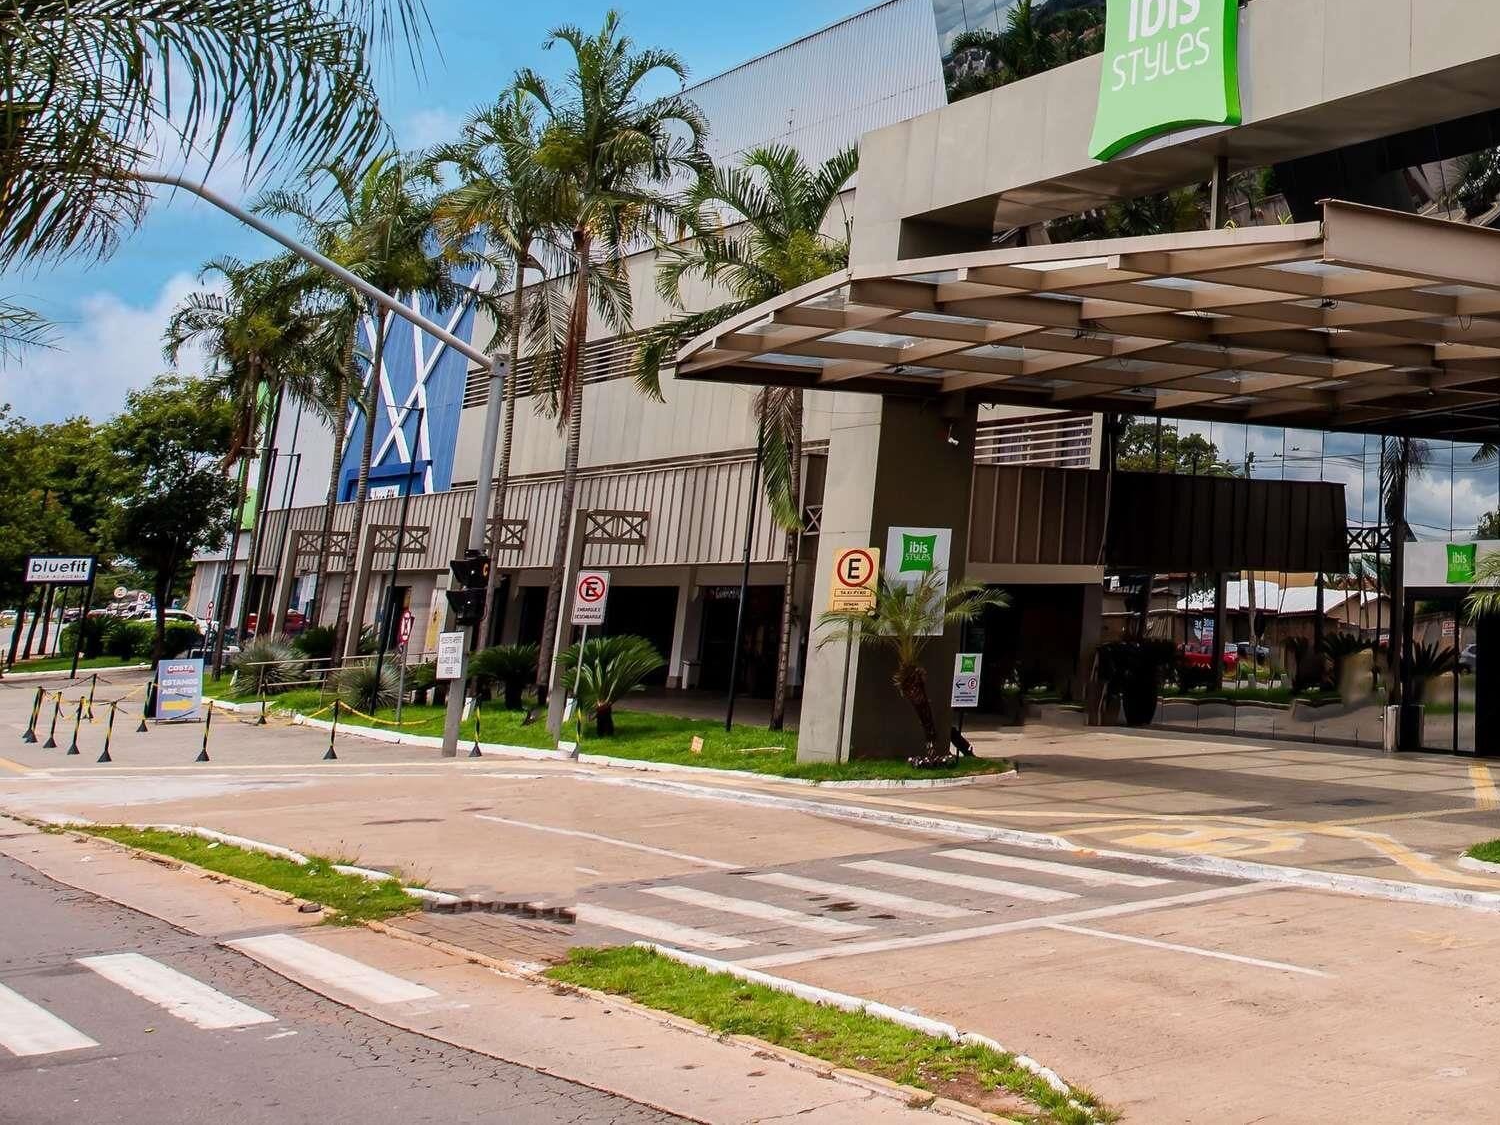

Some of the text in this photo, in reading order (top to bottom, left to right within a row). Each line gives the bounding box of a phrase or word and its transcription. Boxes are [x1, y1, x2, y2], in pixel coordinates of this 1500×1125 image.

[909, 541, 928, 554] ibis
[1452, 551, 1468, 564] ibis
[32, 560, 88, 572] bluefit
[847, 558, 862, 579] E
